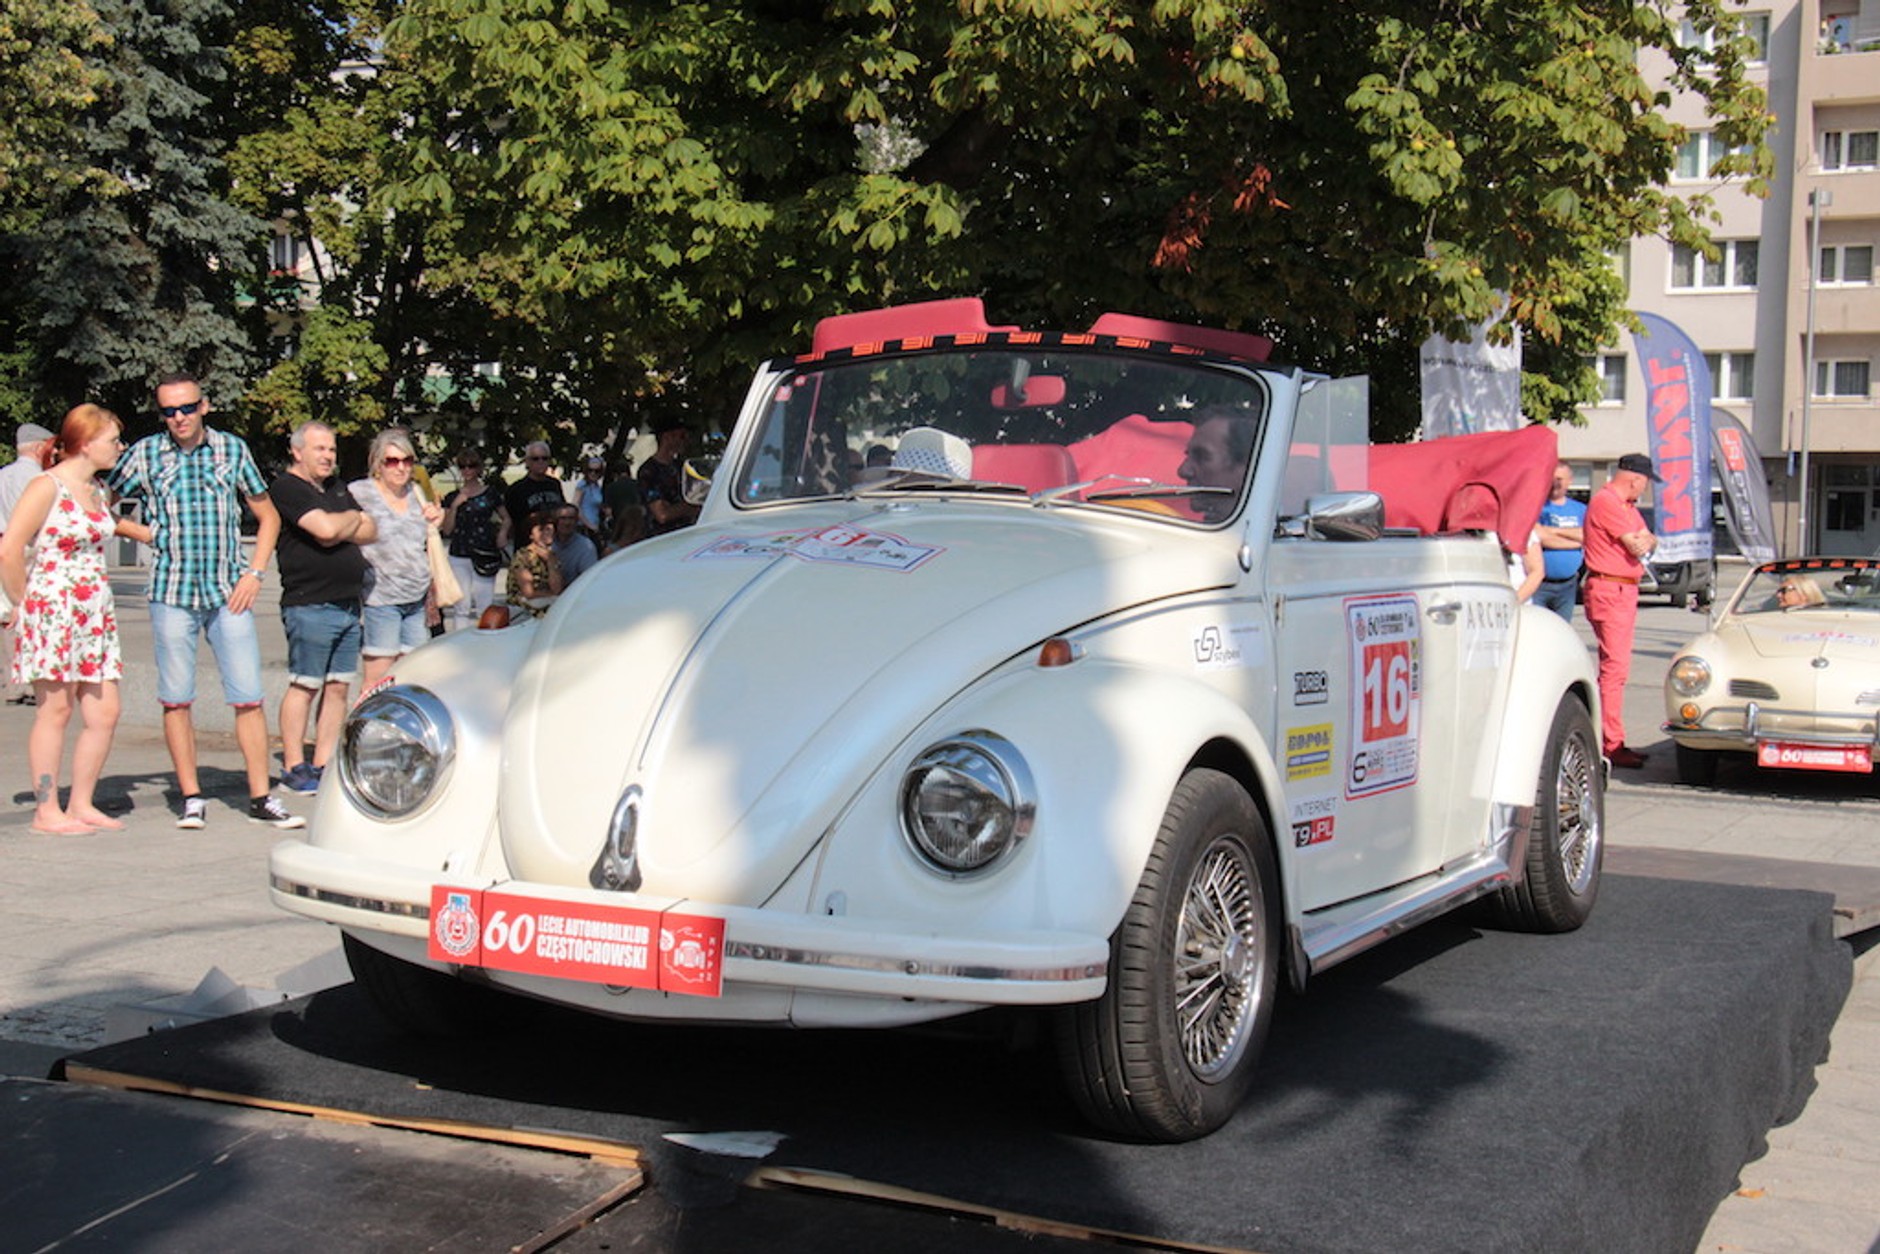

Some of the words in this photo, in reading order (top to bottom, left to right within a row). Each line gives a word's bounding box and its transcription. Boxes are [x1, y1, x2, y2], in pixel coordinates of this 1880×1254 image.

[1466, 601, 1510, 629] ARCHE
[1294, 670, 1328, 693] TURBO
[1365, 653, 1409, 729] 16
[1781, 748, 1802, 763] 60
[1295, 796, 1337, 817] INTERNET
[483, 910, 536, 954] 60
[538, 914, 565, 934] LECIE
[565, 918, 650, 944] AUTOMOBILKLUB
[536, 934, 648, 970] CZĘSTOCHOWSKI
